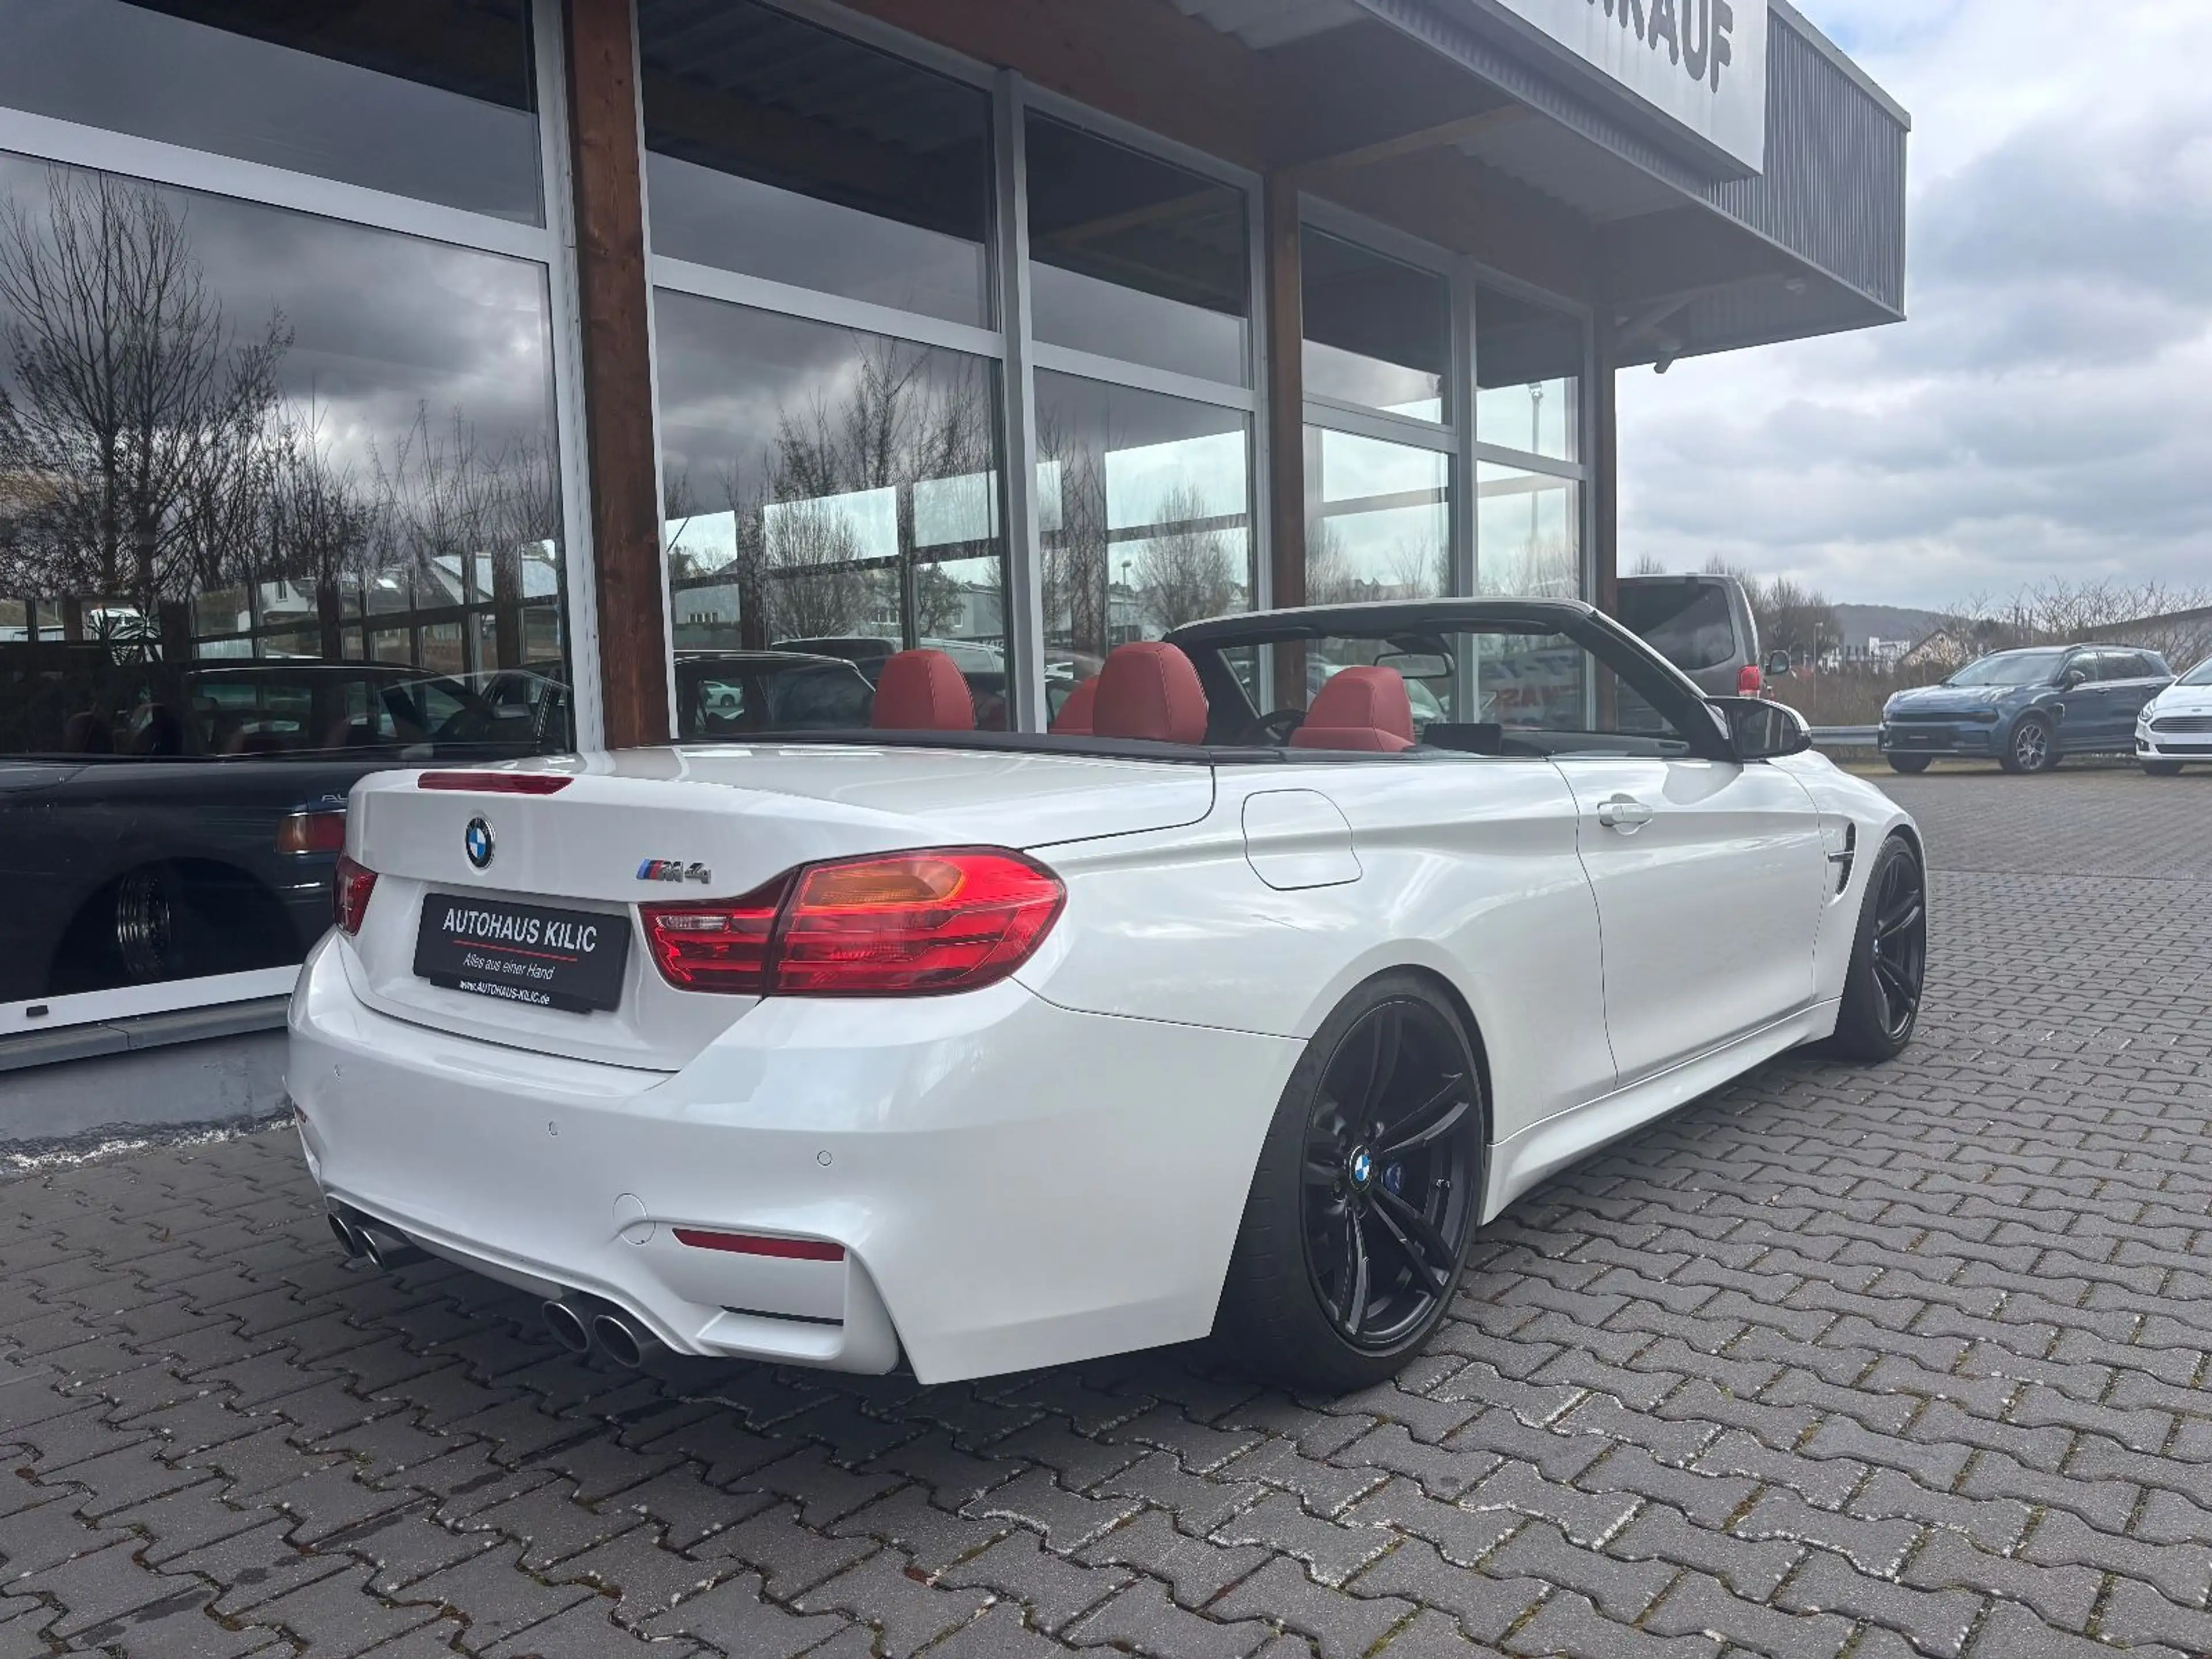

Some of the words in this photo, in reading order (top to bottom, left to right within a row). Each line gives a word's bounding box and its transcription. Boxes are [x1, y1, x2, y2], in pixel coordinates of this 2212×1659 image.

[657, 860, 711, 884] M4
[442, 908, 540, 944] AUTOHAUS
[543, 921, 597, 952] KILIC
[463, 952, 484, 969] Alles
[485, 959, 501, 972] aus
[503, 960, 527, 976] einer
[527, 963, 555, 980] Hand
[460, 980, 550, 1005] www.AUTOHAUS-KILIC.de
